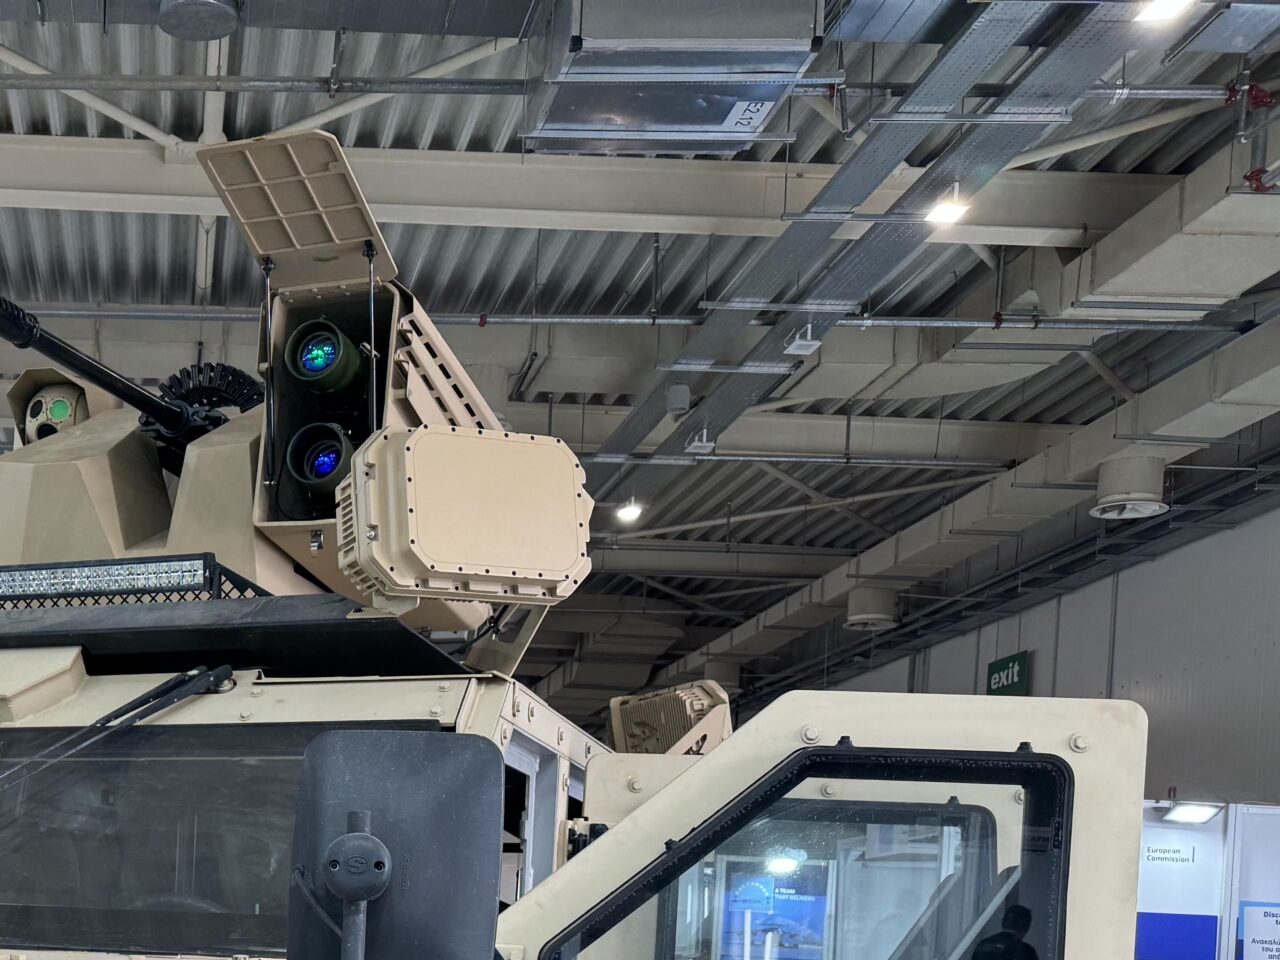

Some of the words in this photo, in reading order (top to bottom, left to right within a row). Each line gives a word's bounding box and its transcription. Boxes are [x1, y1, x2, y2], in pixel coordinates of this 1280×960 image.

[735, 102, 765, 126] E2.12
[991, 661, 1019, 689] exit
[1146, 846, 1181, 854] European
